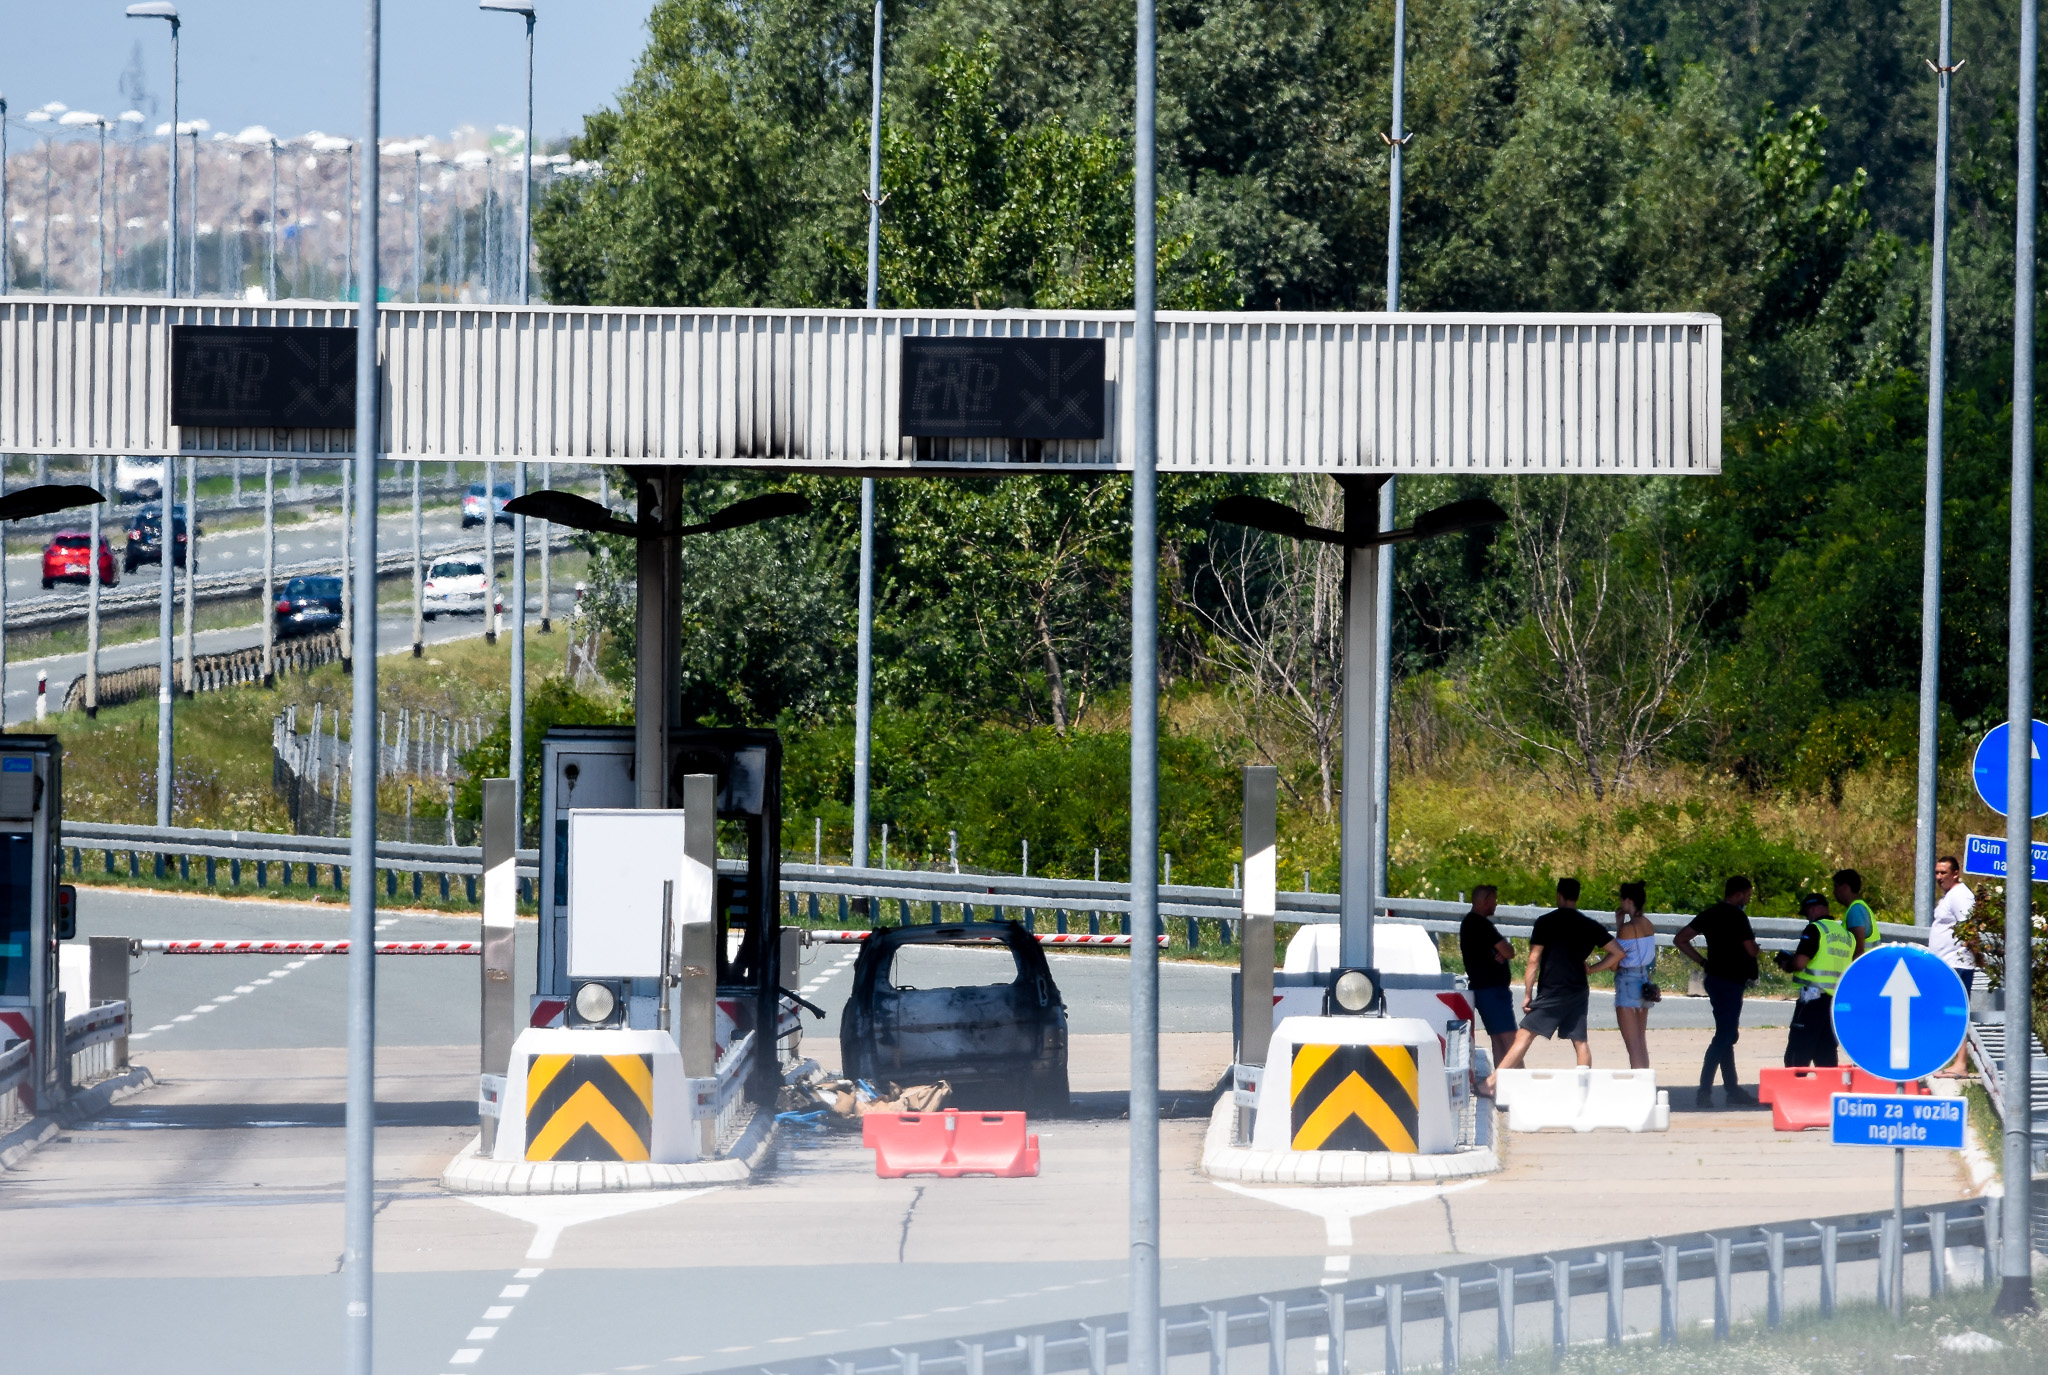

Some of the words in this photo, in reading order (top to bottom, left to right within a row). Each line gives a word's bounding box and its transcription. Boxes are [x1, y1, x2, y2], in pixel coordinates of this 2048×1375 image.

[1972, 839, 2000, 855] Osim
[1837, 1099, 1876, 1117] Osim
[1884, 1104, 1903, 1118] za
[1912, 1102, 1959, 1121] vozila
[1869, 1122, 1927, 1143] naplate
